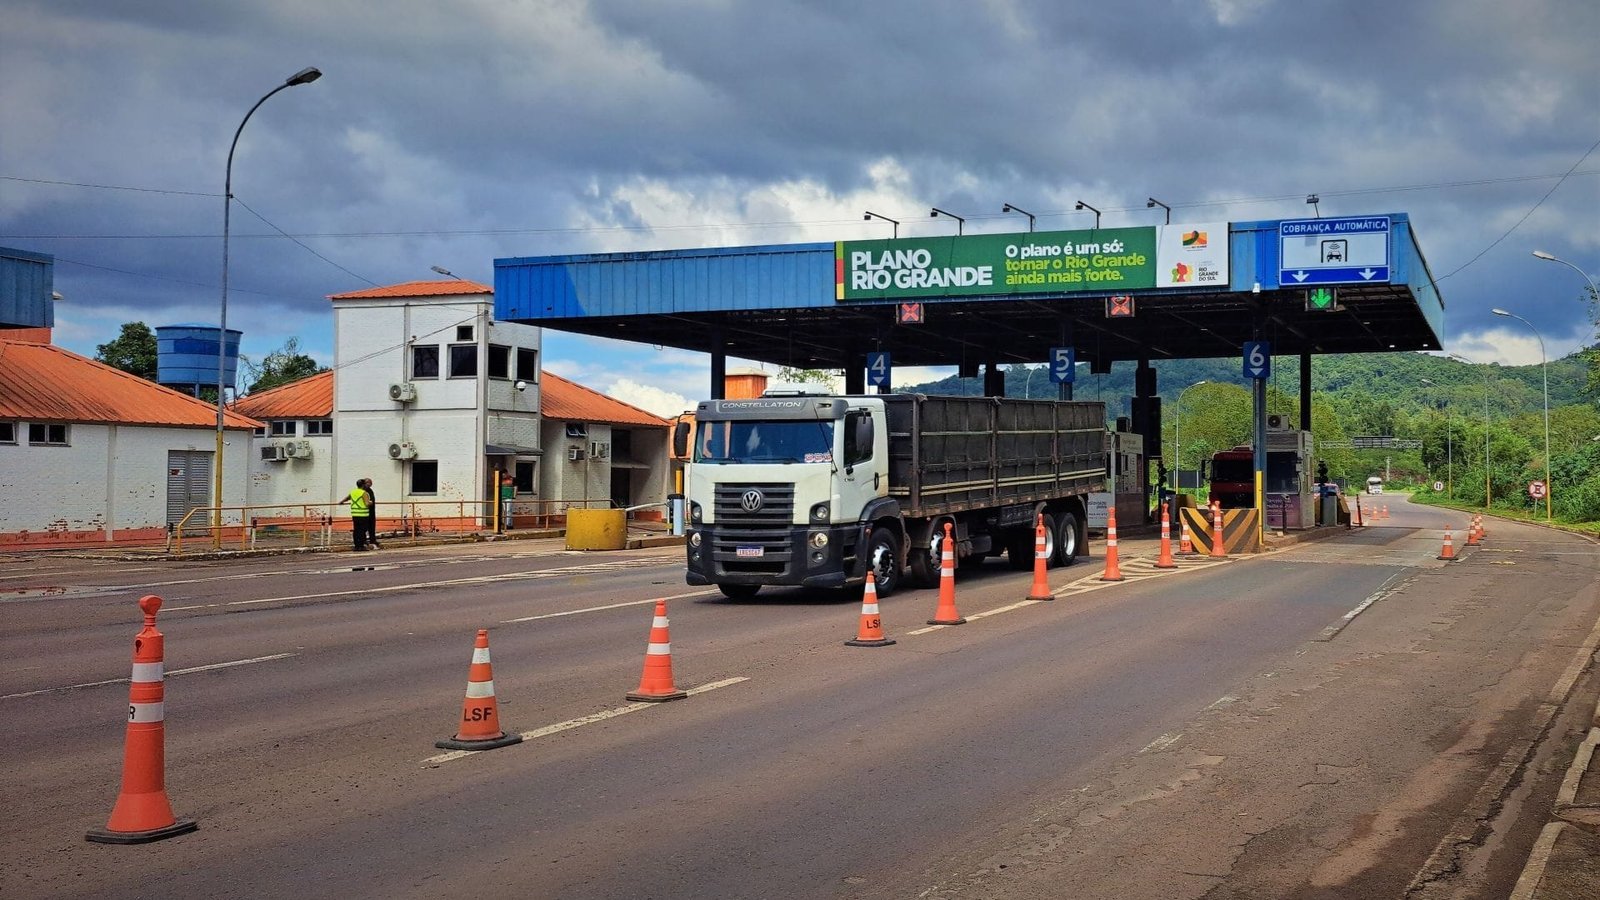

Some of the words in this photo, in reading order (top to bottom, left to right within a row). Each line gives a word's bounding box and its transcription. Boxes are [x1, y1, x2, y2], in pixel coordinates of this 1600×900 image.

[1283, 223, 1331, 233] COBRANÇA
[1334, 220, 1387, 231] AUTOMÁTICA
[851, 249, 932, 271] PLANO
[1005, 244, 1018, 258] O
[1020, 243, 1061, 260] plano
[1063, 241, 1073, 255] é
[1075, 242, 1100, 254] um
[1102, 239, 1124, 253] só:
[1005, 259, 1050, 271] tornar
[1052, 259, 1063, 269] o
[1065, 255, 1089, 269] Rio
[1092, 253, 1146, 268] Grande
[852, 269, 892, 290] RIO
[894, 265, 993, 289] GRANDE
[1005, 270, 1045, 285] ainda
[1048, 269, 1082, 283] mais
[1084, 268, 1124, 282] forte.
[871, 354, 886, 376] 4
[1055, 349, 1070, 372] 5
[1249, 344, 1264, 367] 6
[721, 401, 801, 409] CONSTELLATION
[464, 707, 493, 722] LSF
